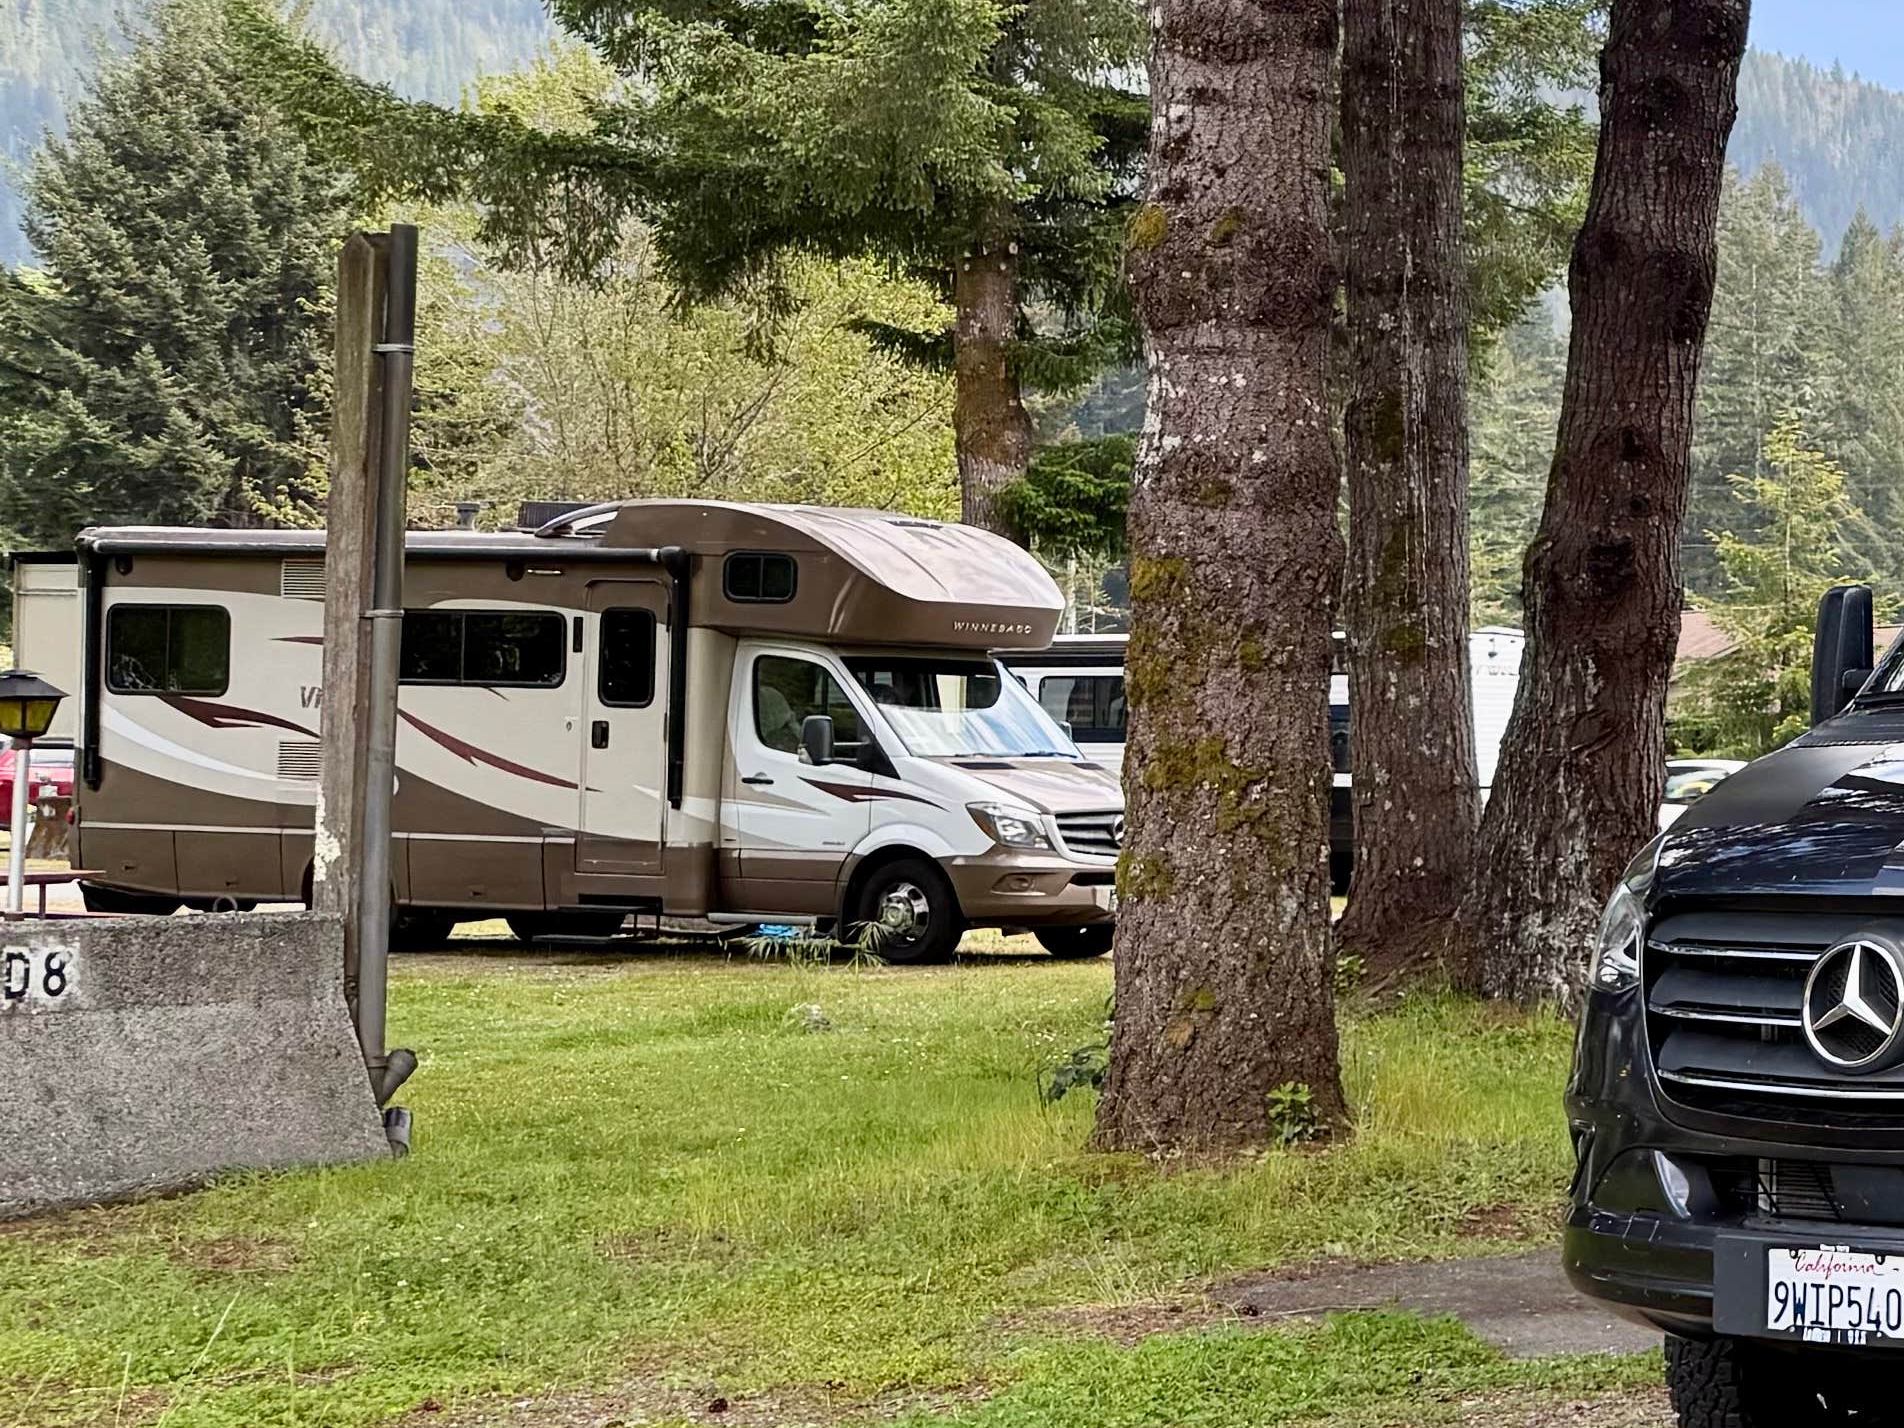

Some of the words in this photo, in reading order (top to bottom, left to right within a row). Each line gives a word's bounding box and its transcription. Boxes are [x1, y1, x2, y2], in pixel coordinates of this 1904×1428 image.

[953, 620, 1032, 634] WINNEBAGO
[4, 951, 68, 1000] D8
[1794, 1250, 1884, 1280] California
[1773, 1280, 1902, 1332] 9WIP540
